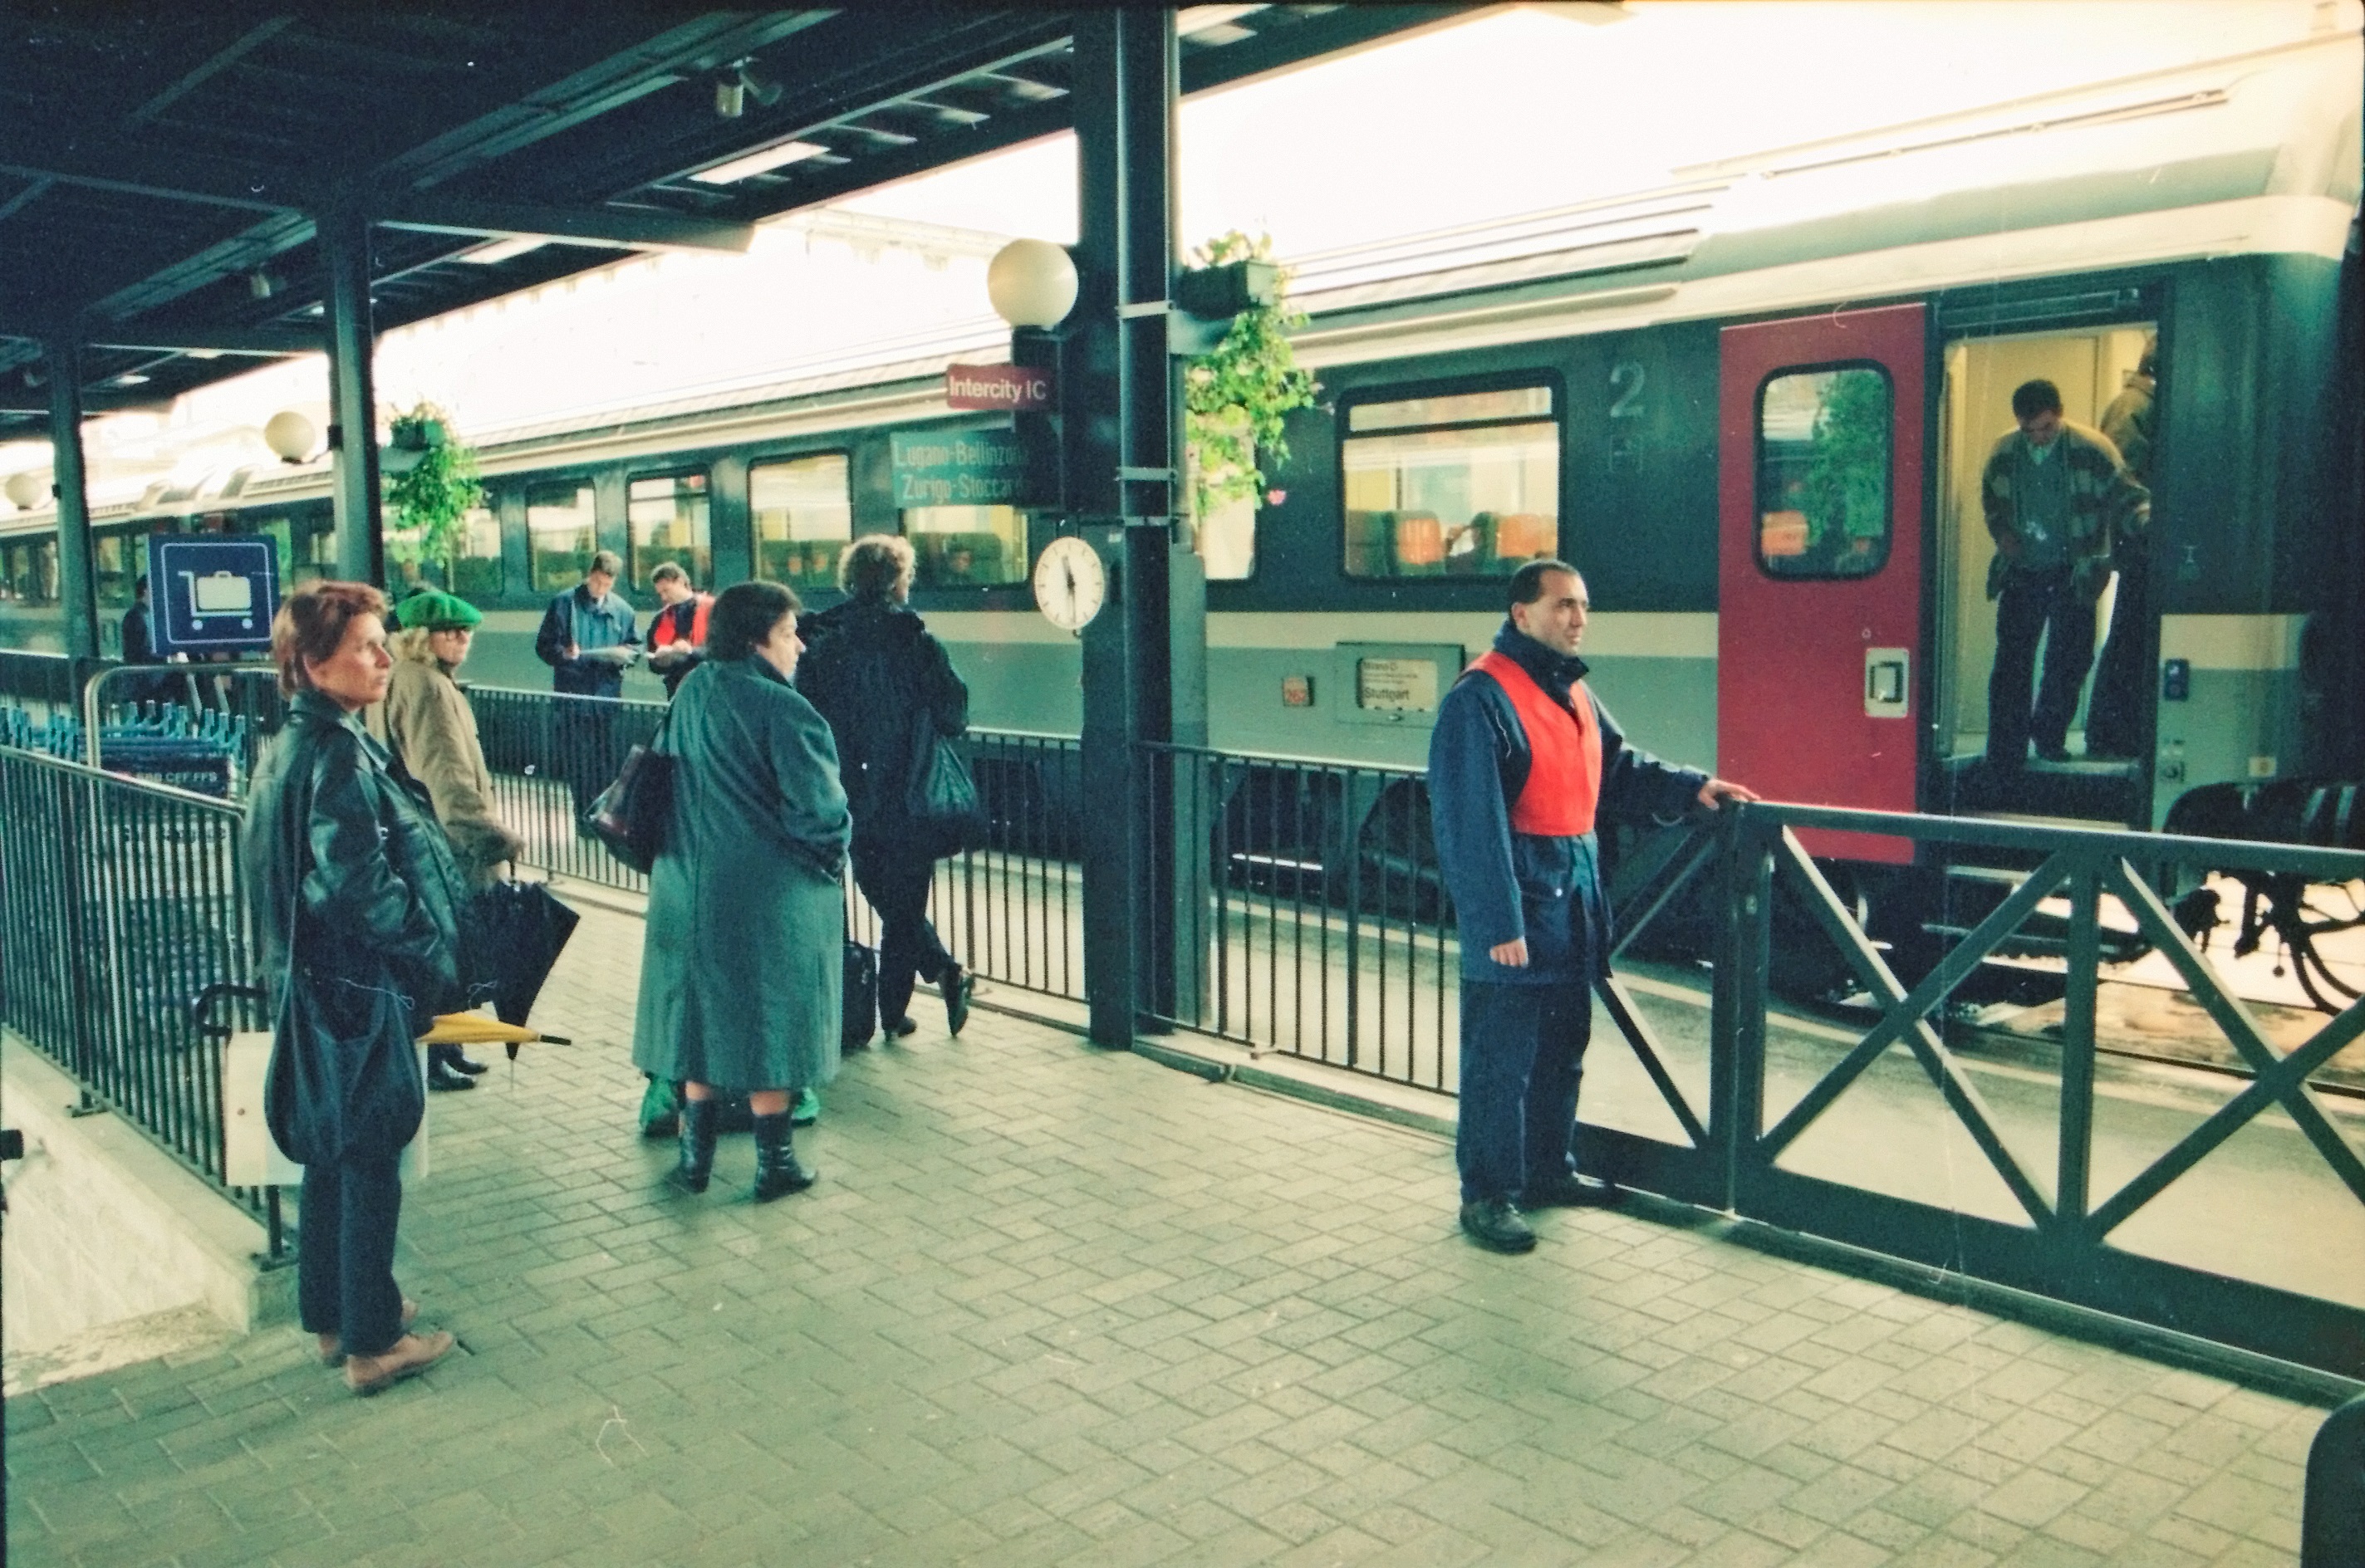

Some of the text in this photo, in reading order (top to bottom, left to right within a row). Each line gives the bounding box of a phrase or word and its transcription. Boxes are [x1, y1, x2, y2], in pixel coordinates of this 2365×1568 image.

[949, 375, 1047, 404] Intercity IC
[1609, 360, 1646, 419] 2
[1363, 687, 1410, 703] Stuttgart
